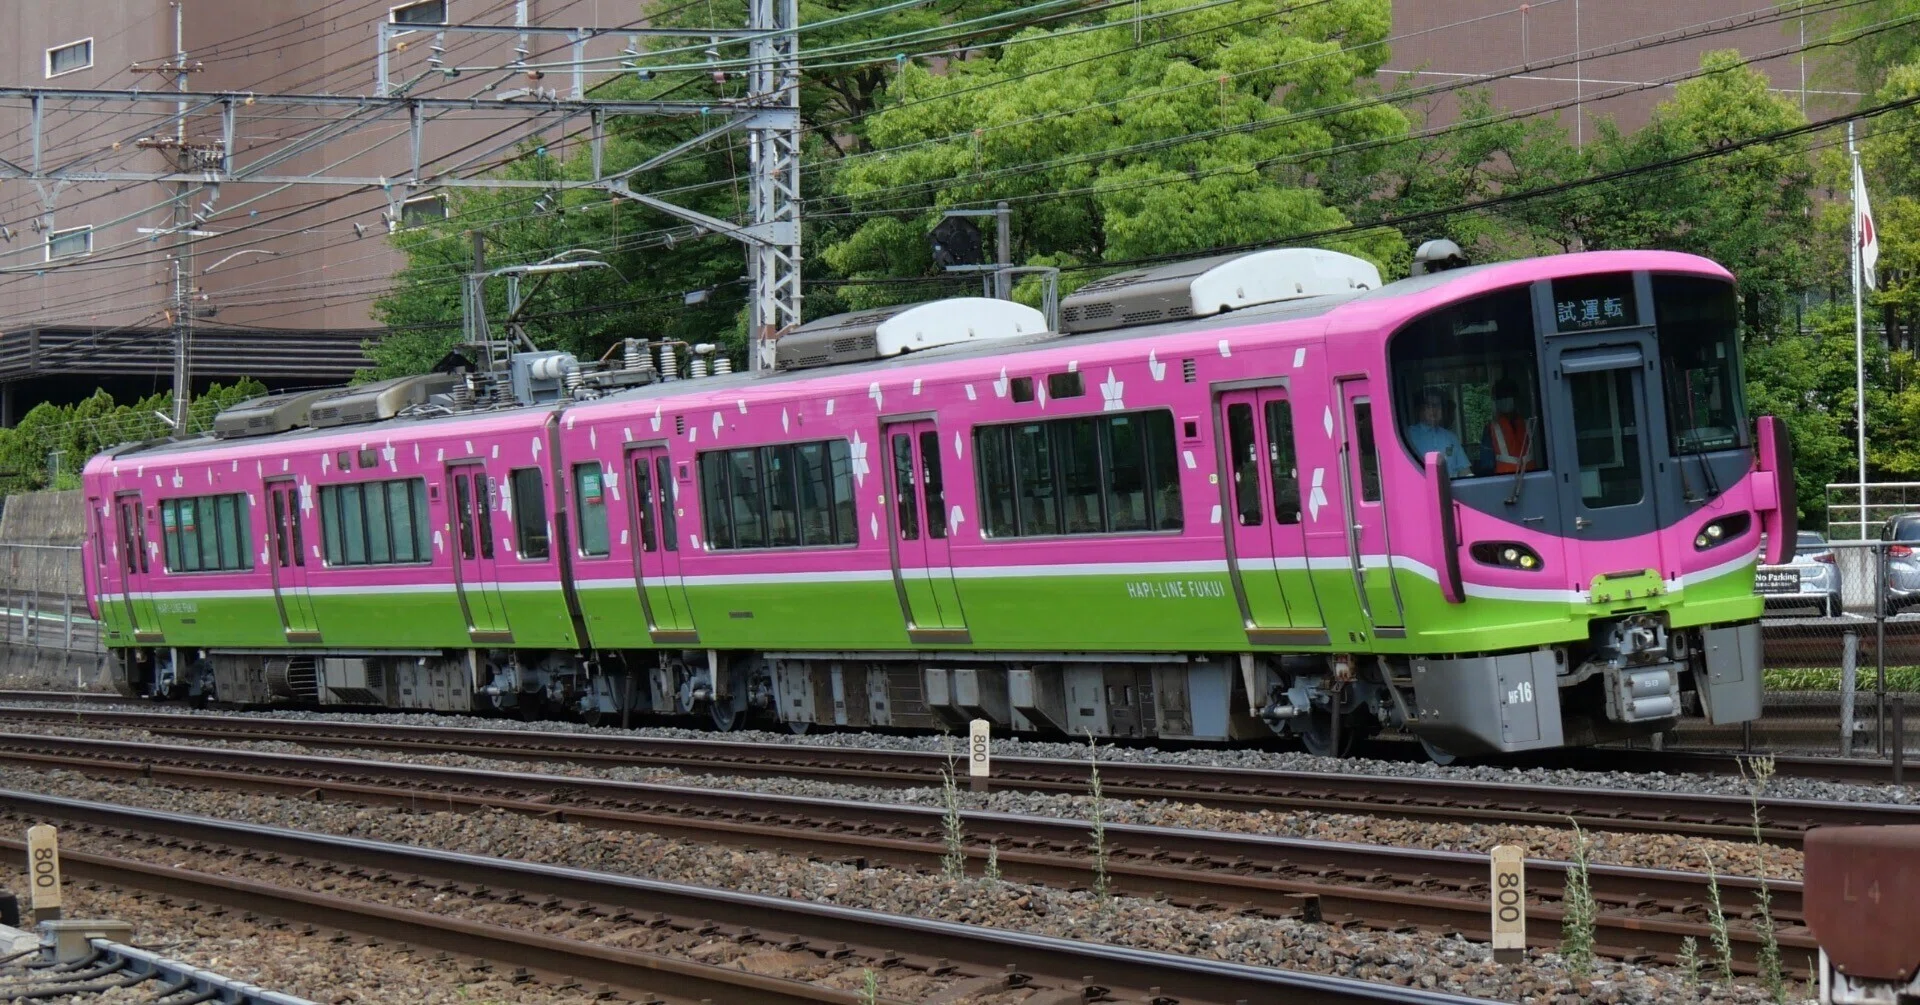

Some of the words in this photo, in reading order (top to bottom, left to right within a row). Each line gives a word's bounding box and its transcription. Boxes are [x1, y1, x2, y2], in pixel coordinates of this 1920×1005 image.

[1557, 297, 1623, 322] 試運転
[1126, 582, 1187, 598] HAPI-LINE
[1188, 581, 1225, 597] FUKUI
[1768, 572, 1798, 583] Parking
[1508, 681, 1532, 704] HF16
[973, 734, 987, 762] 800
[34, 847, 55, 888] 800
[1498, 872, 1520, 922] 800
